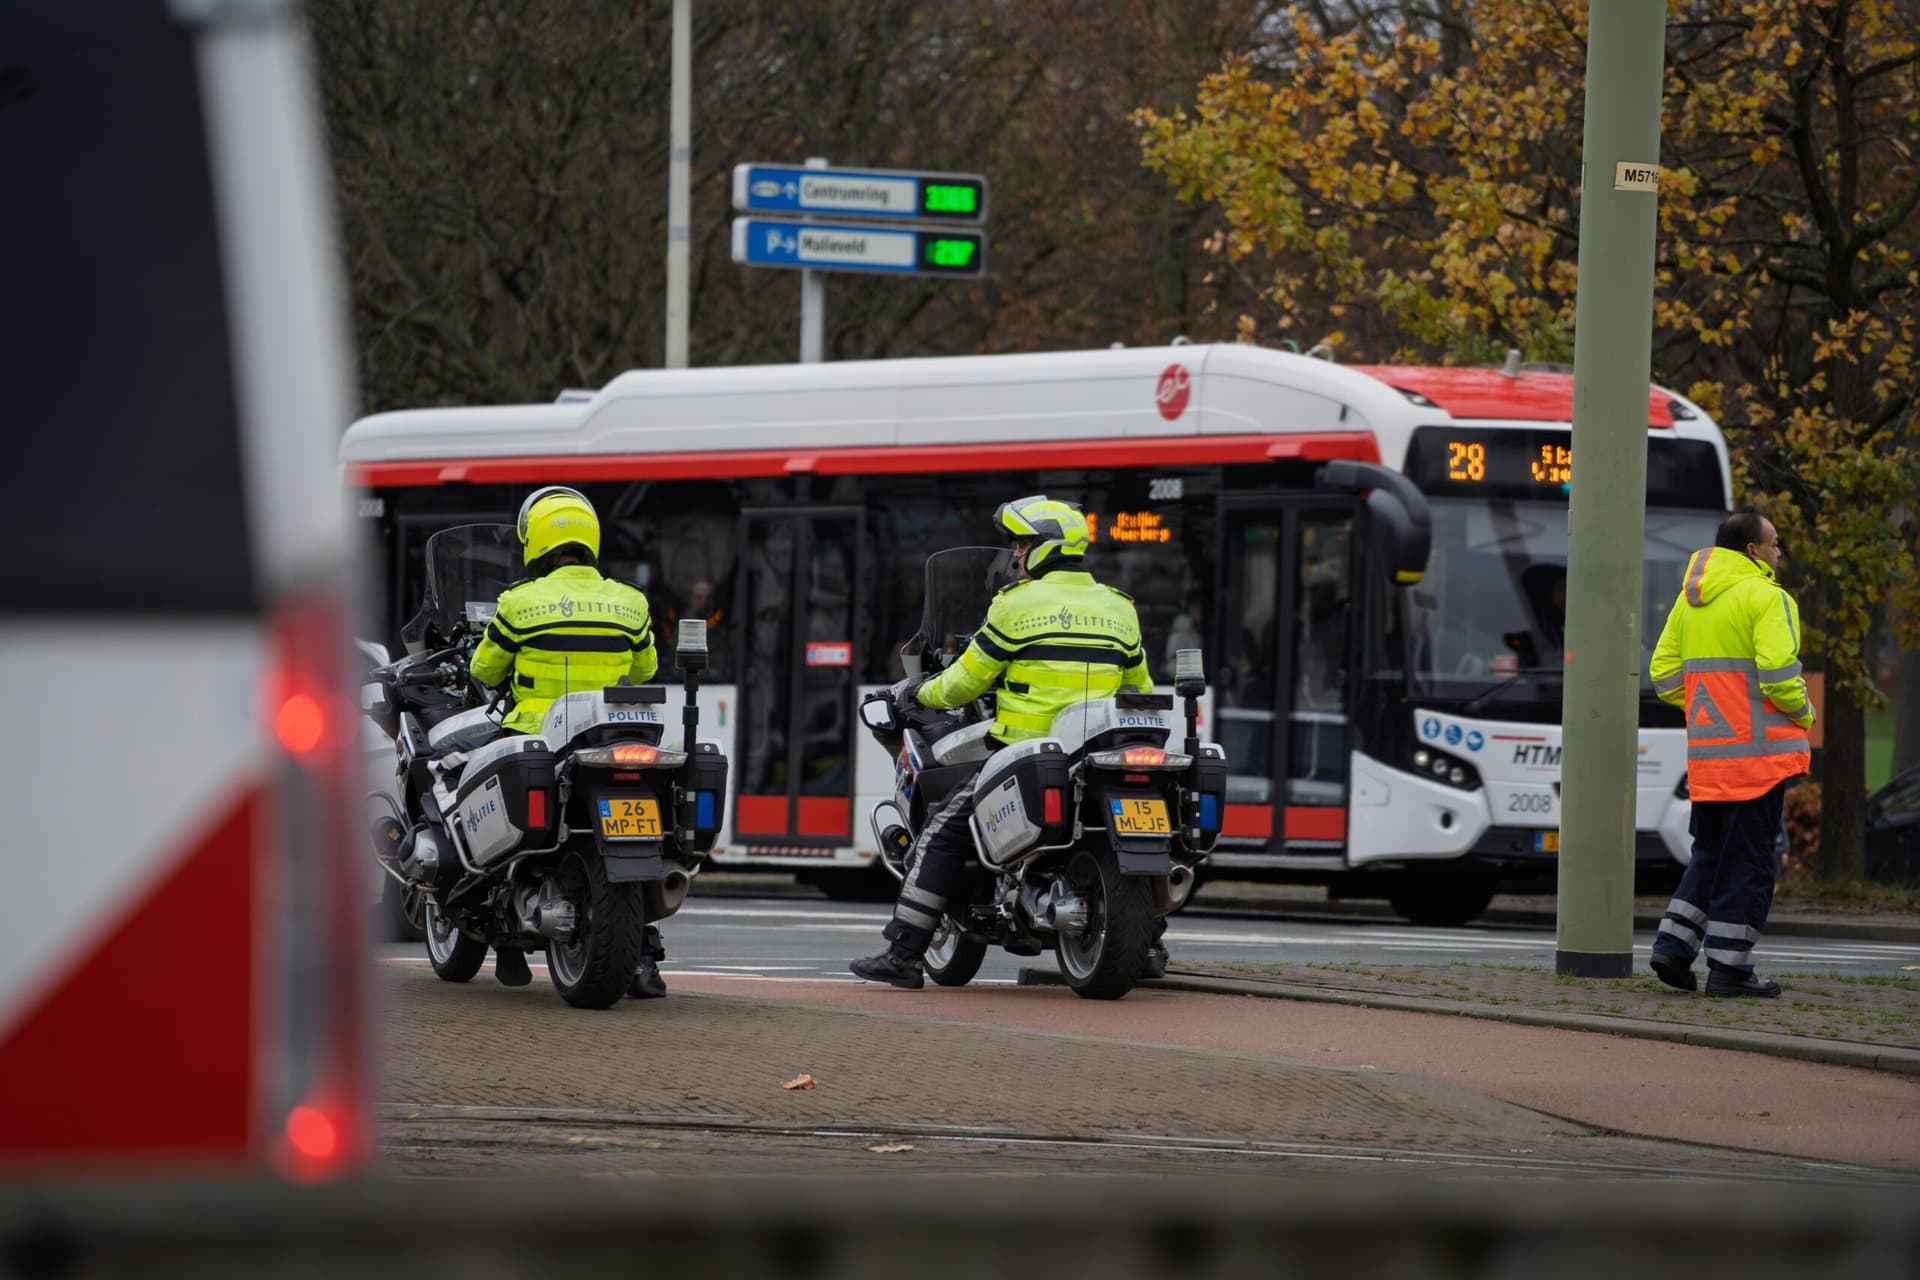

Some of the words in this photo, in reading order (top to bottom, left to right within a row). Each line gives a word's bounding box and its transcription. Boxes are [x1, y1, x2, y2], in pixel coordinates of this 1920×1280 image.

[803, 182, 888, 205] Centrumring
[803, 235, 866, 255] Malieveld
[1449, 442, 1485, 480] 28
[1148, 478, 1183, 499] 2008
[548, 594, 621, 618] POLITIE
[1049, 605, 1113, 631] POLITIE
[608, 711, 657, 721] POLITIE
[1119, 716, 1165, 727] POLITIE
[1512, 744, 1562, 766] HTM
[622, 801, 645, 816] 26
[1134, 801, 1152, 815] 15
[1508, 793, 1552, 813] 2008
[467, 799, 496, 833] POLITIE
[605, 818, 657, 834] MP-FT
[986, 800, 1017, 833] POLITIE
[1119, 817, 1165, 831] ML-JF
